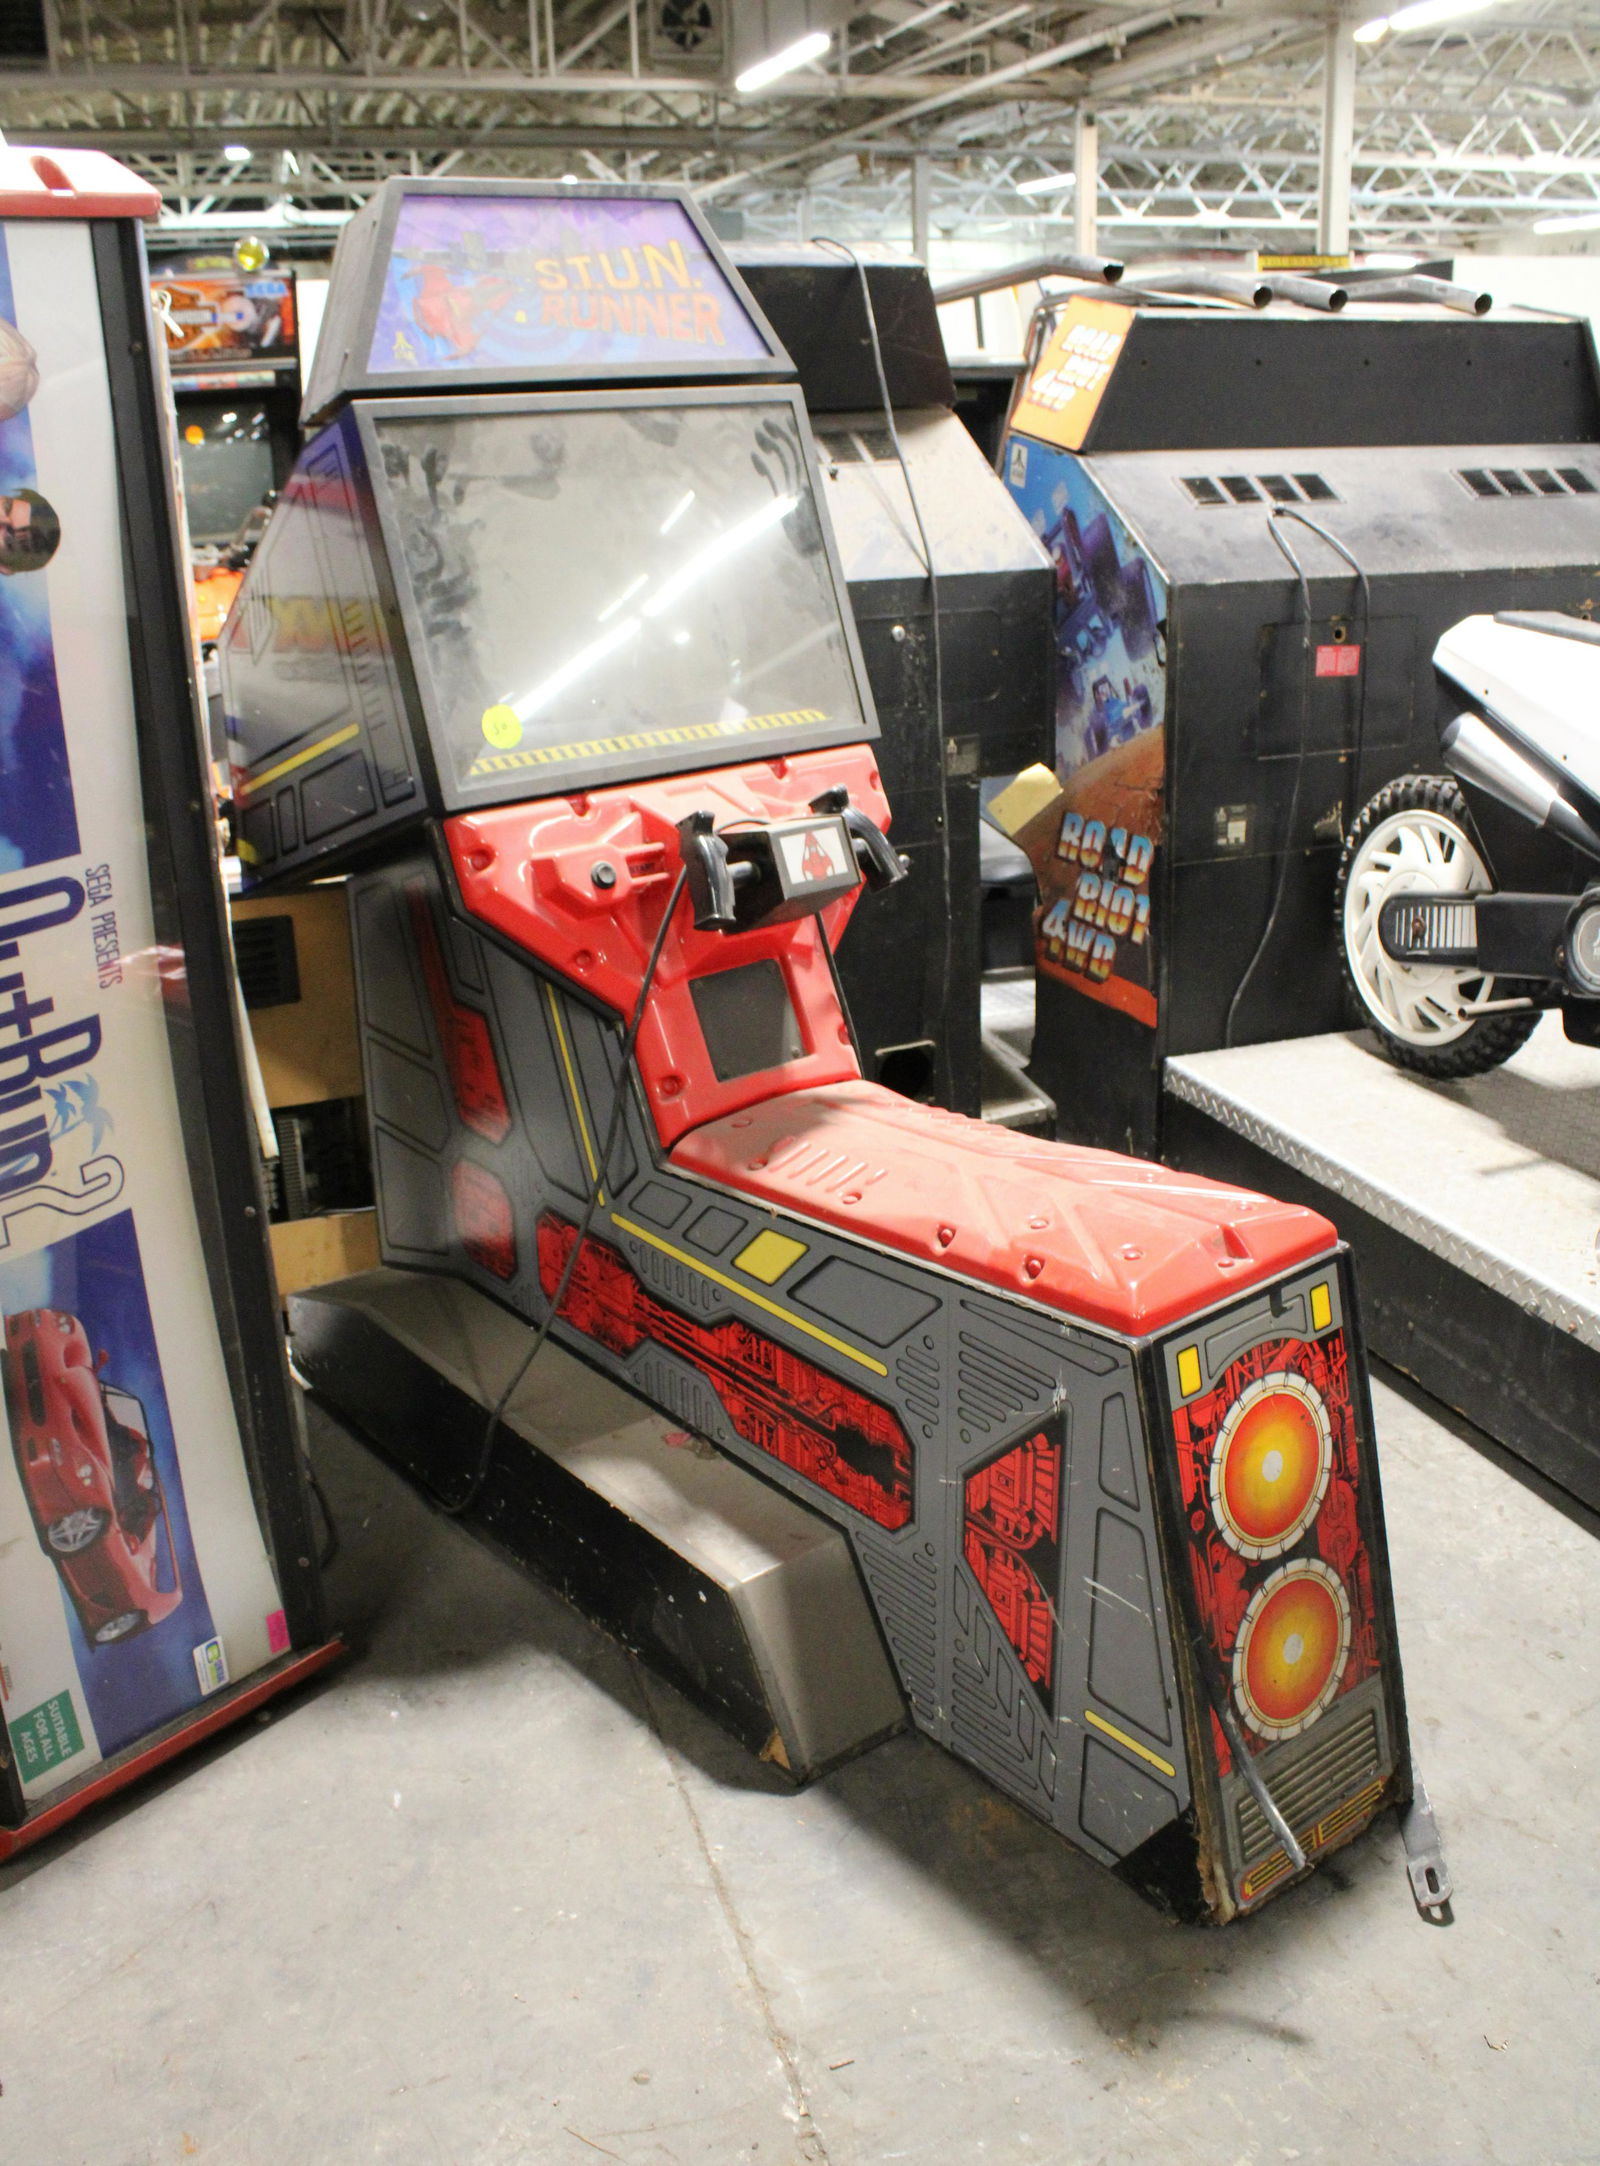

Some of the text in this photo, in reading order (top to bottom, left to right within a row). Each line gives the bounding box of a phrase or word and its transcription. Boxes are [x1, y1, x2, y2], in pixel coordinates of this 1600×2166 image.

[541, 293, 725, 345] RUNNER
[85, 864, 123, 989] SEGA PRESENTS
[1043, 898, 1116, 983] 4WD
[1073, 872, 1150, 945] RIOT
[0, 1154, 125, 1248] 2
[20, 1731, 38, 1763] AGES
[33, 1711, 55, 1762] FOR ALL
[48, 1700, 72, 1757] SUITABLE
